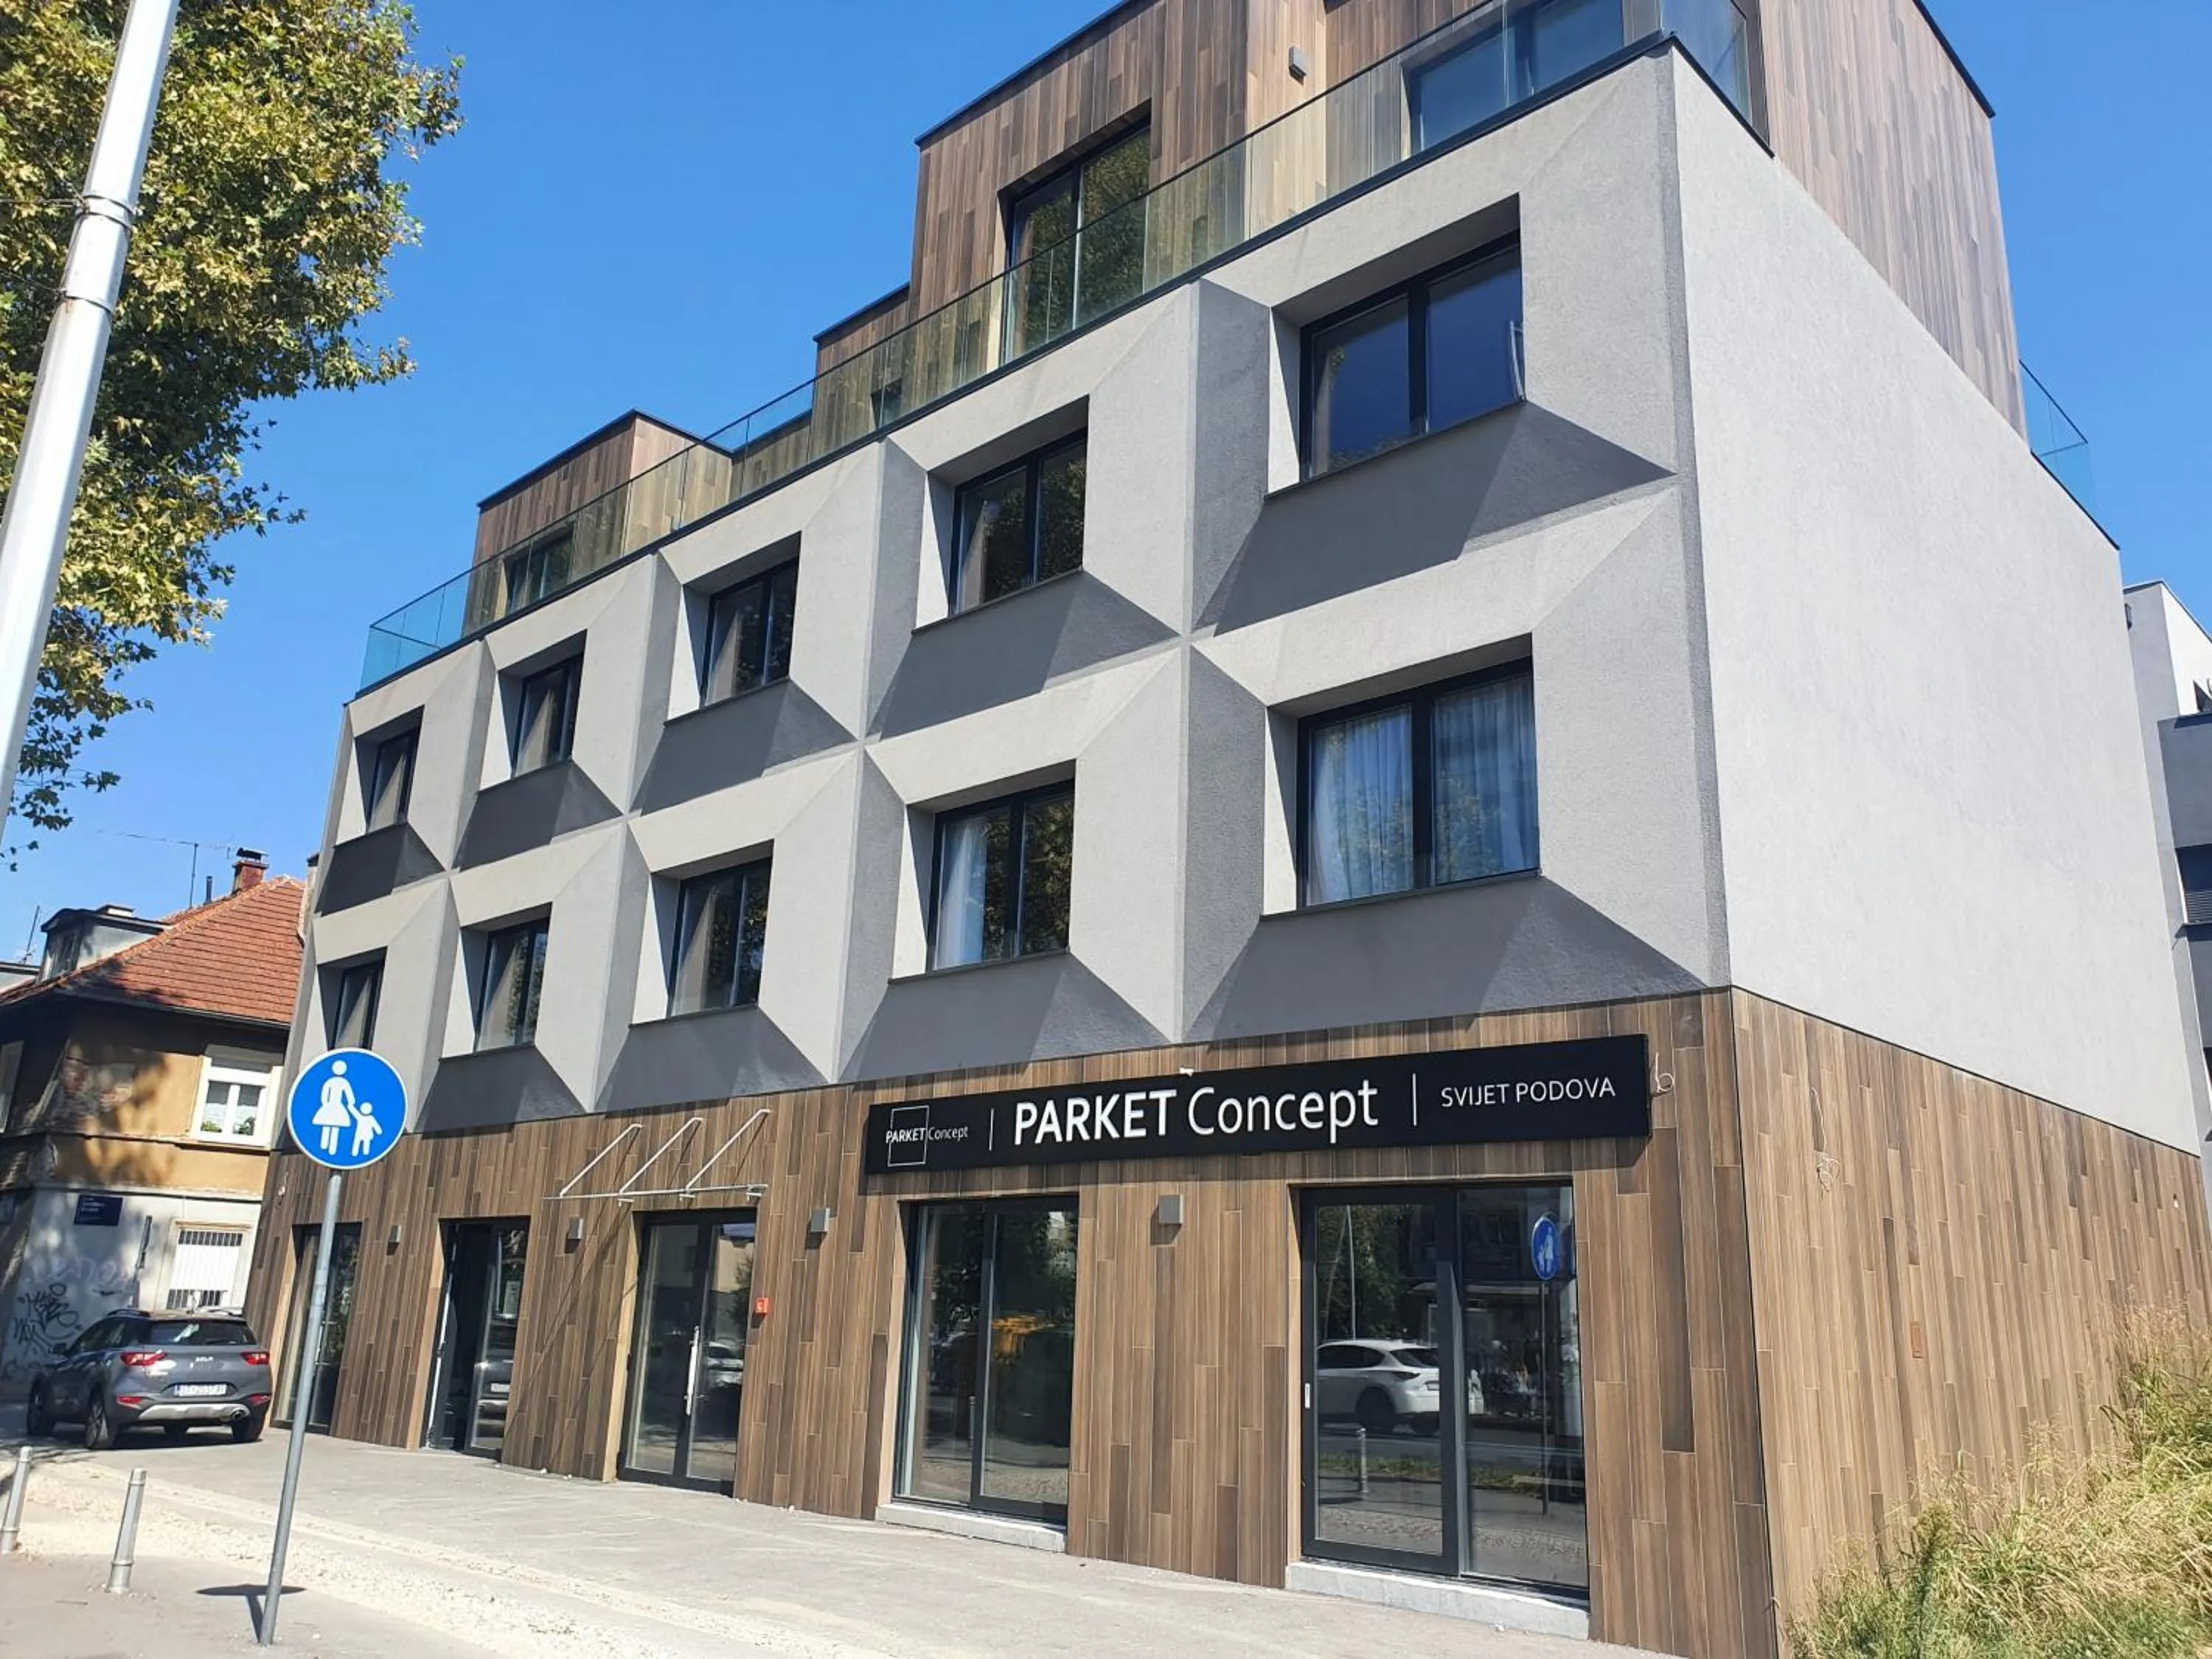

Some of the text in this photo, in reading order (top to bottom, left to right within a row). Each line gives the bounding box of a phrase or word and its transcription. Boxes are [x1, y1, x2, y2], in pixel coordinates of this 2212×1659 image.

[1441, 1077, 1616, 1107] SVIJET PODOVA
[1014, 1079, 1380, 1146] PARKET Concept
[886, 1126, 968, 1144] PARKET Concept
